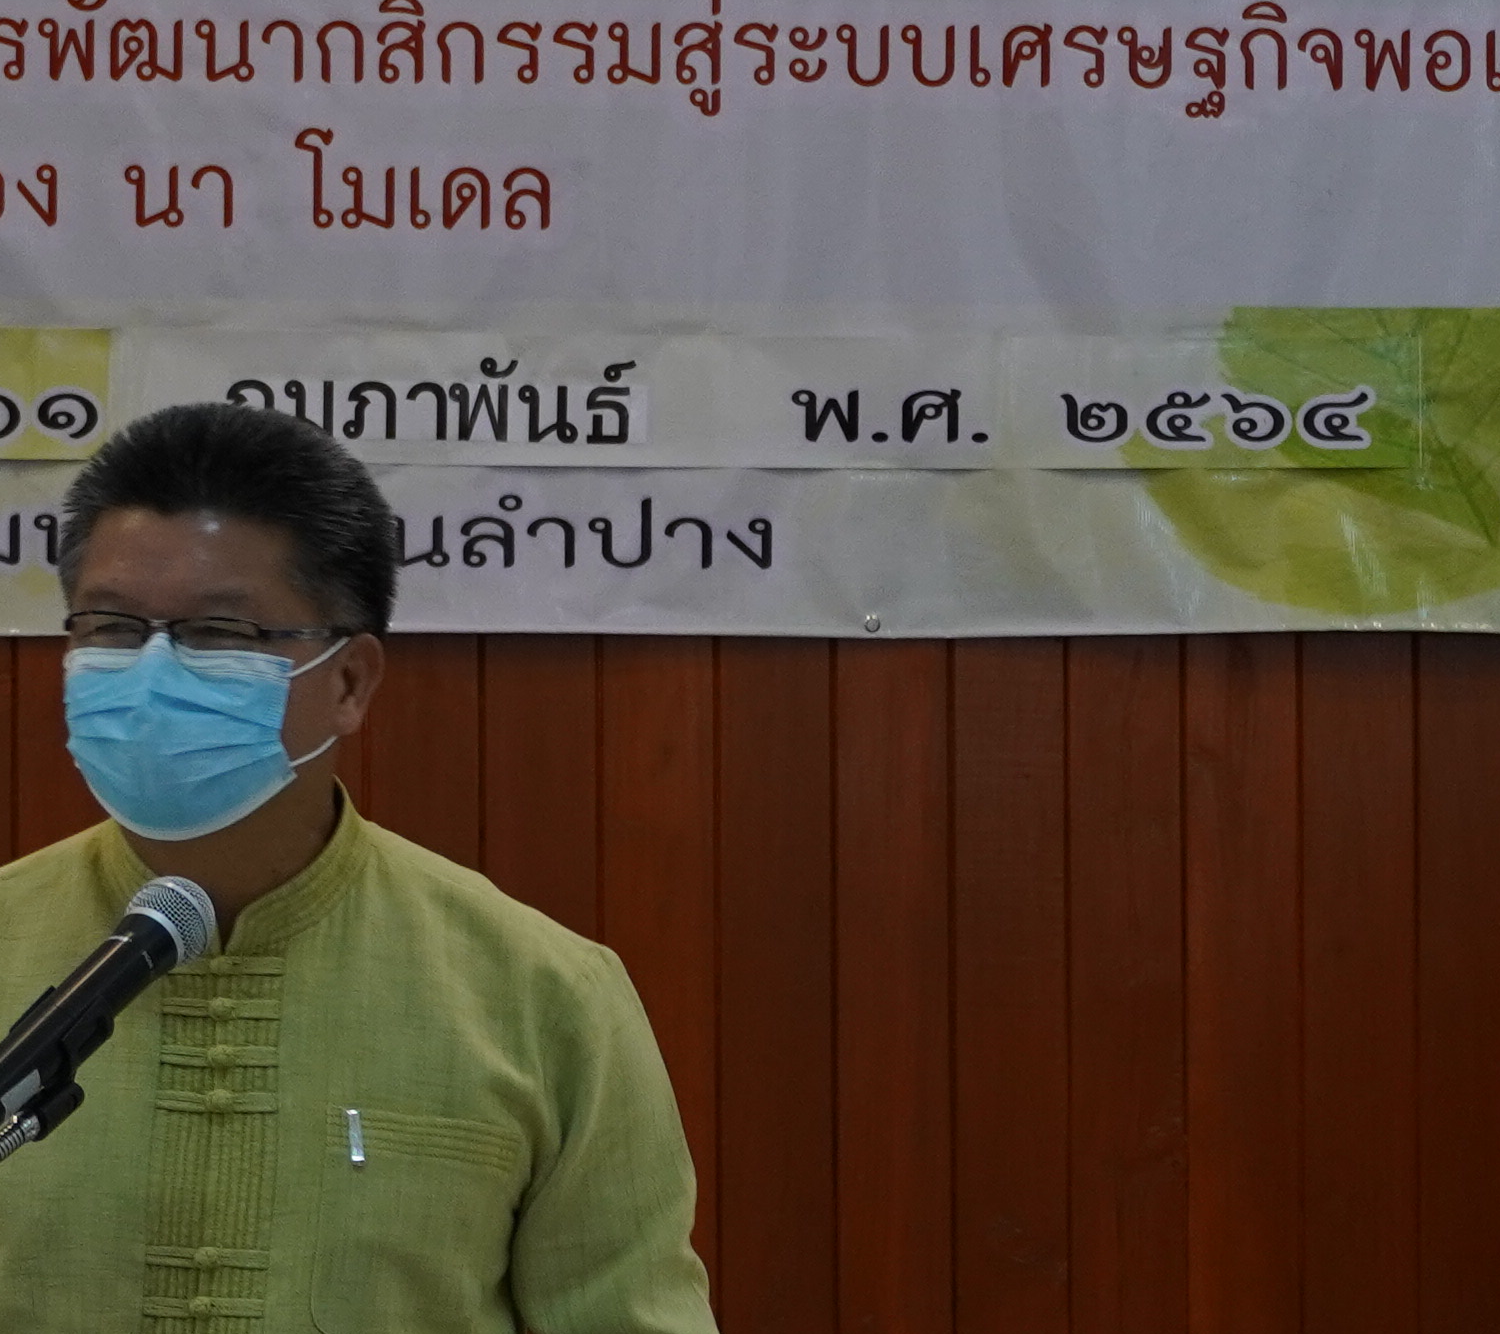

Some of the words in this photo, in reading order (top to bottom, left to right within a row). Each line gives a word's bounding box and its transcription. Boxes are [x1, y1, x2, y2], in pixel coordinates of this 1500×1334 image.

[124, 163, 235, 230] นา
[294, 126, 552, 232] โมเดล
[226, 357, 638, 445] มภาพันธ์
[790, 387, 990, 444] พ.ศ.
[1059, 389, 1369, 444] ๒๕๖๔
